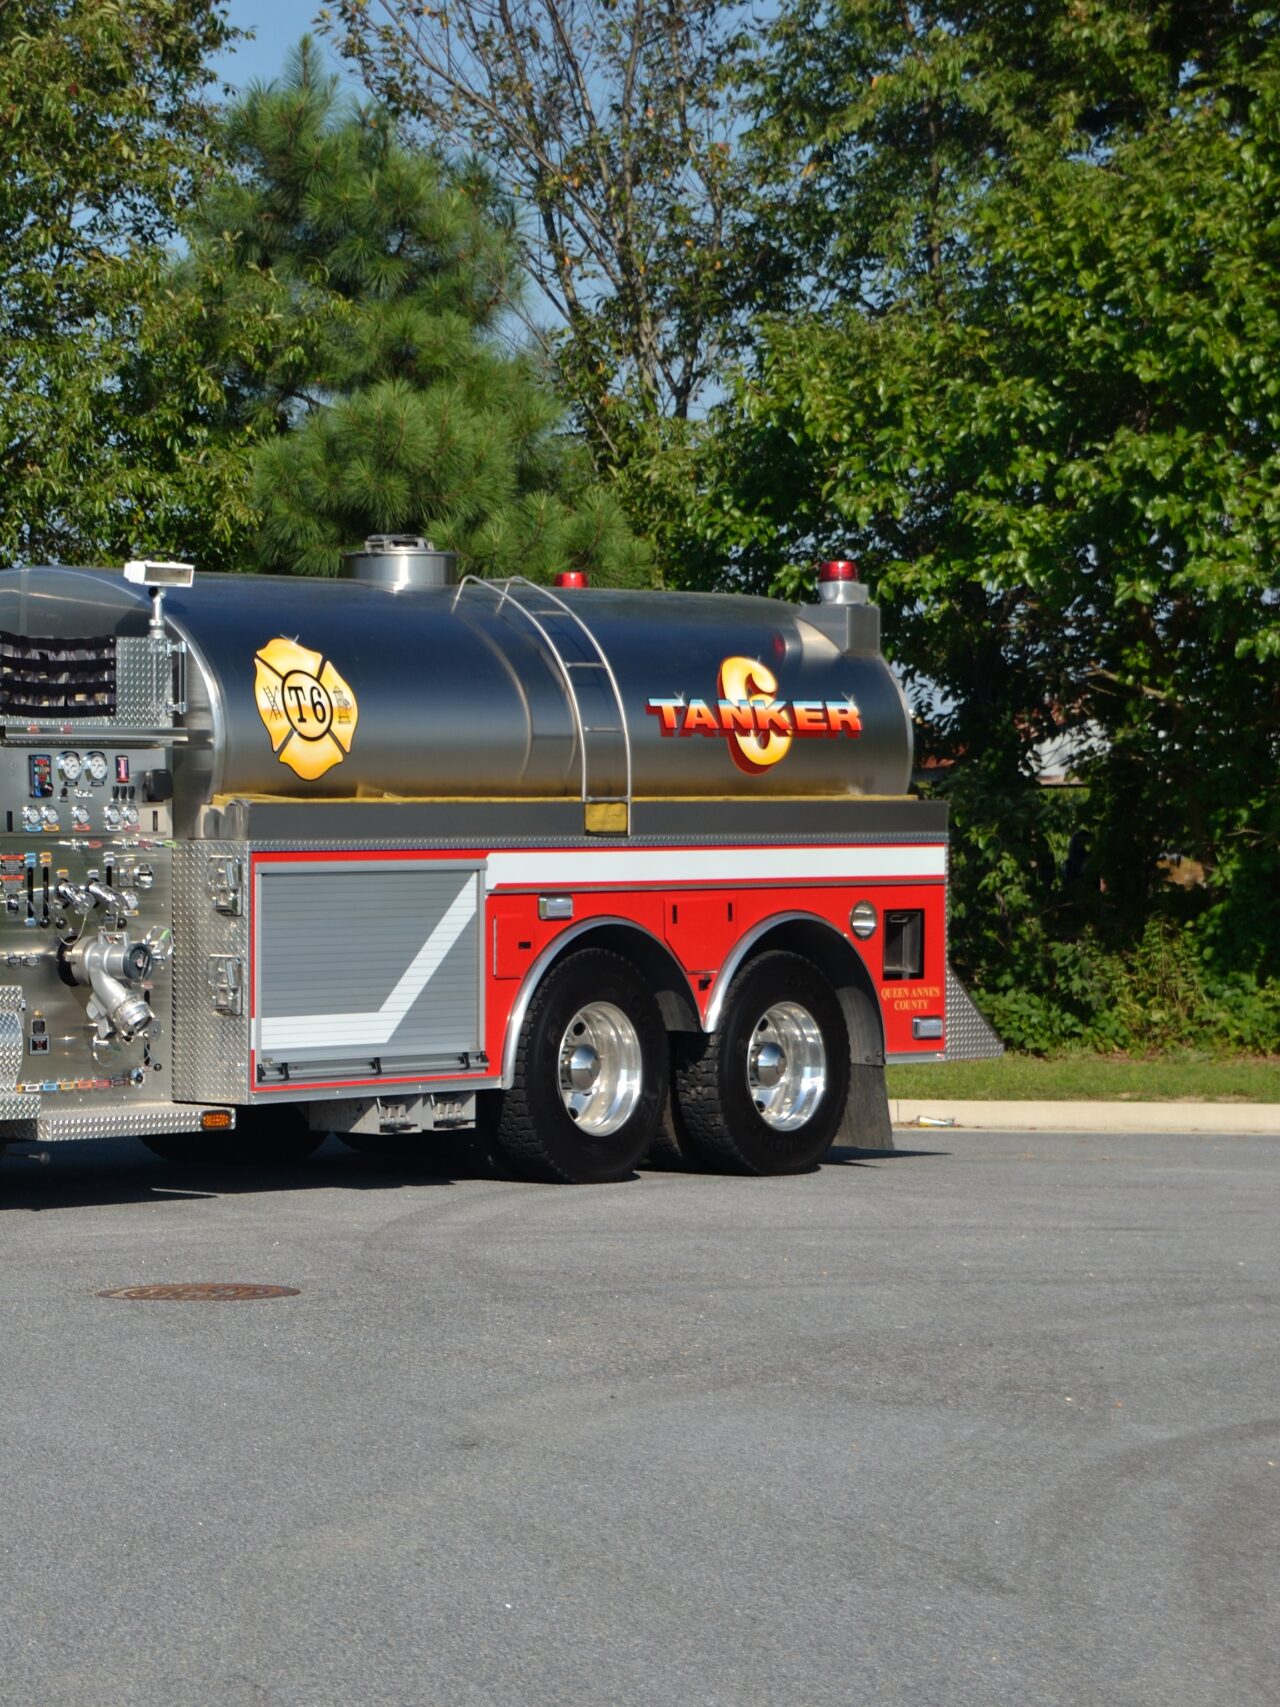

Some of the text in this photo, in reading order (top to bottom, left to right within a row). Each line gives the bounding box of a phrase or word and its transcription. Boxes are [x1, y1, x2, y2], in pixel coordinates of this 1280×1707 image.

[287, 685, 326, 723] T6
[646, 698, 863, 738] TANKER
[881, 988, 909, 1000] QUEEN
[894, 1000, 928, 1010] COUNTY
